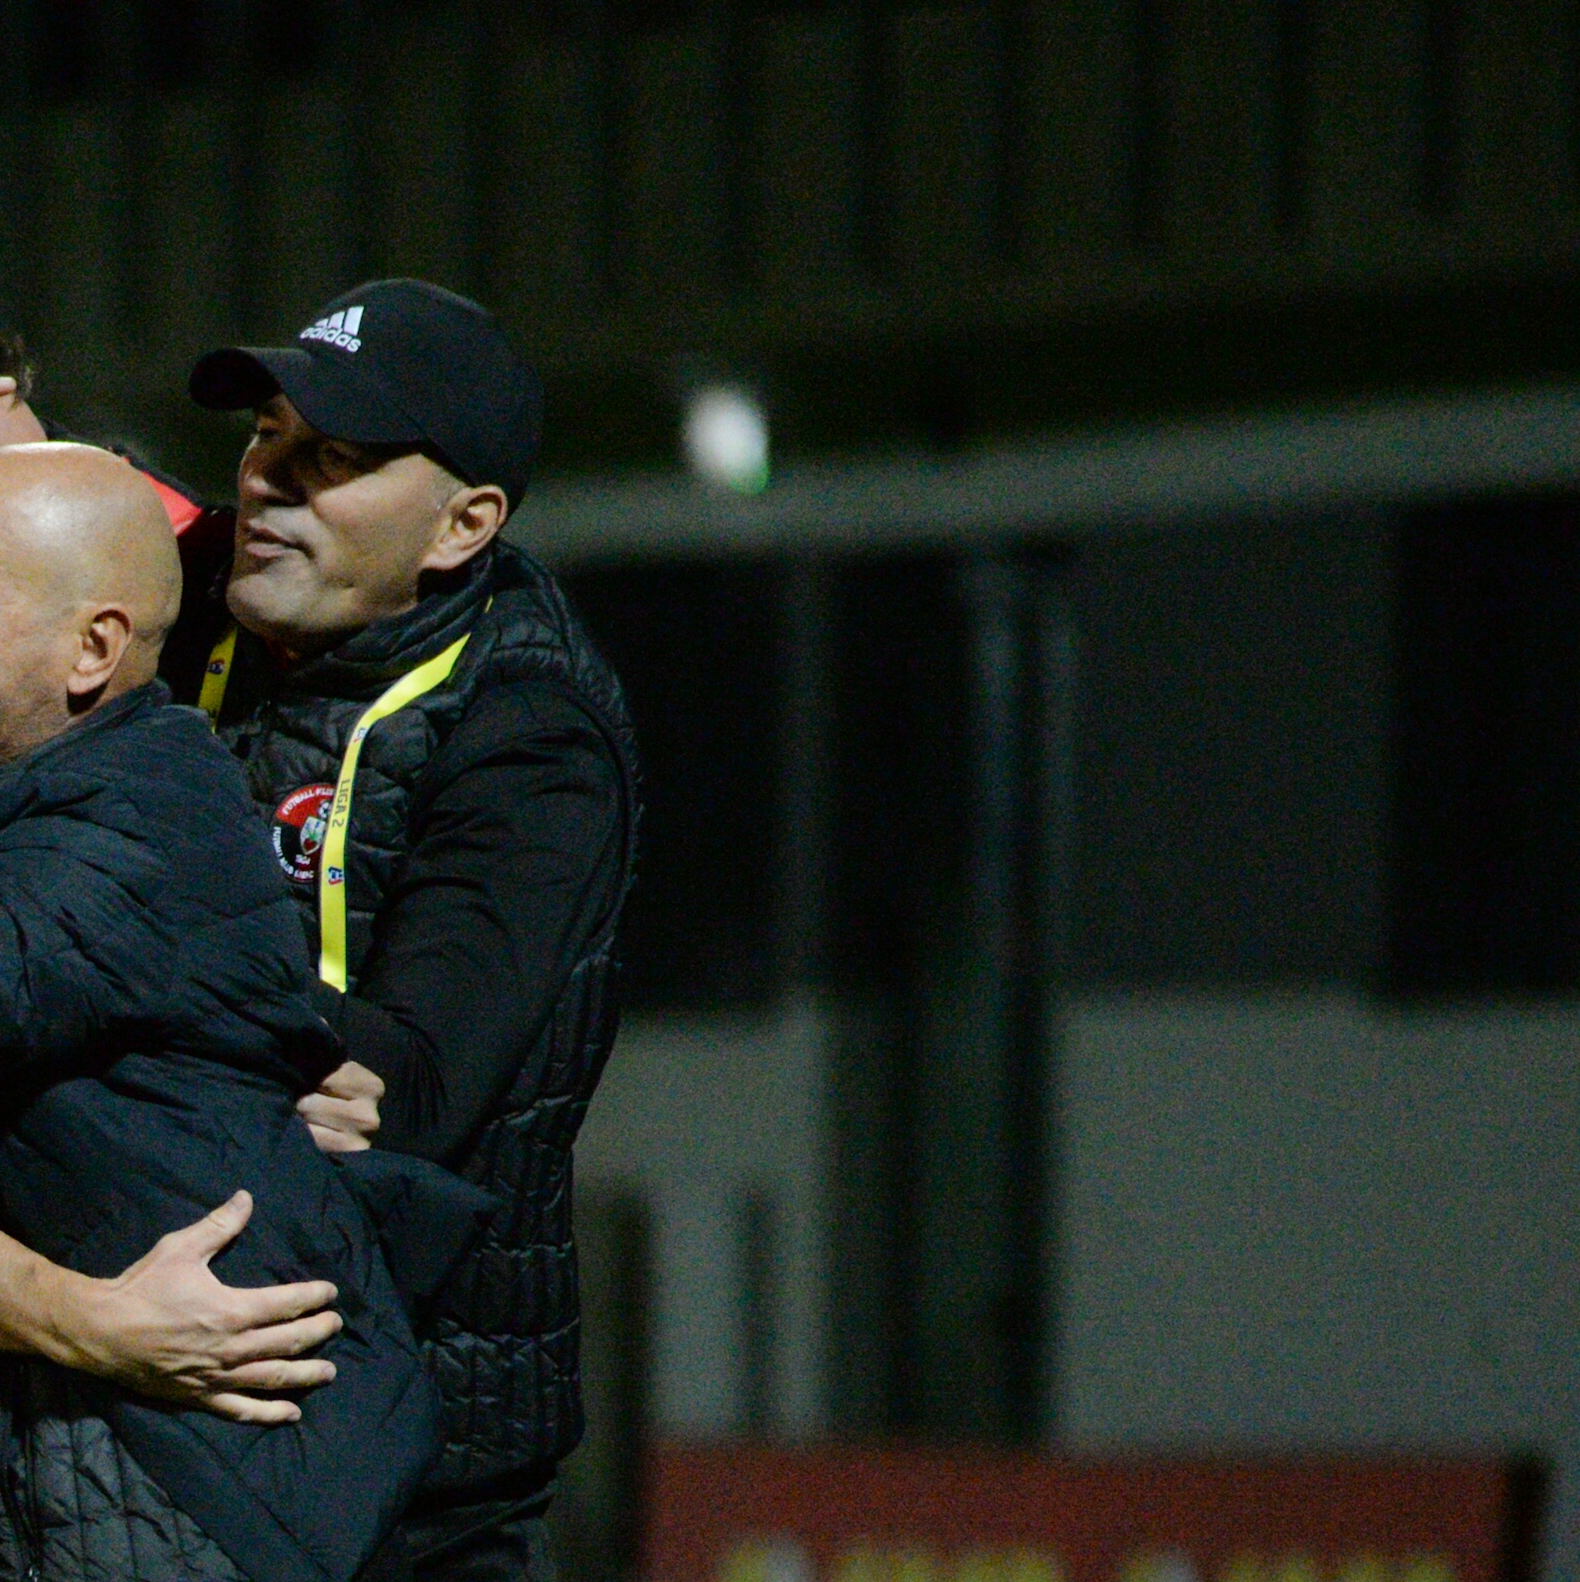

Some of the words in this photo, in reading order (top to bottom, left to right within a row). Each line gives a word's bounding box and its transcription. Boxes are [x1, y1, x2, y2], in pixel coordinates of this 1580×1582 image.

[300, 327, 362, 353] adidas
[335, 778, 351, 815] LIGA
[332, 818, 345, 829] 2
